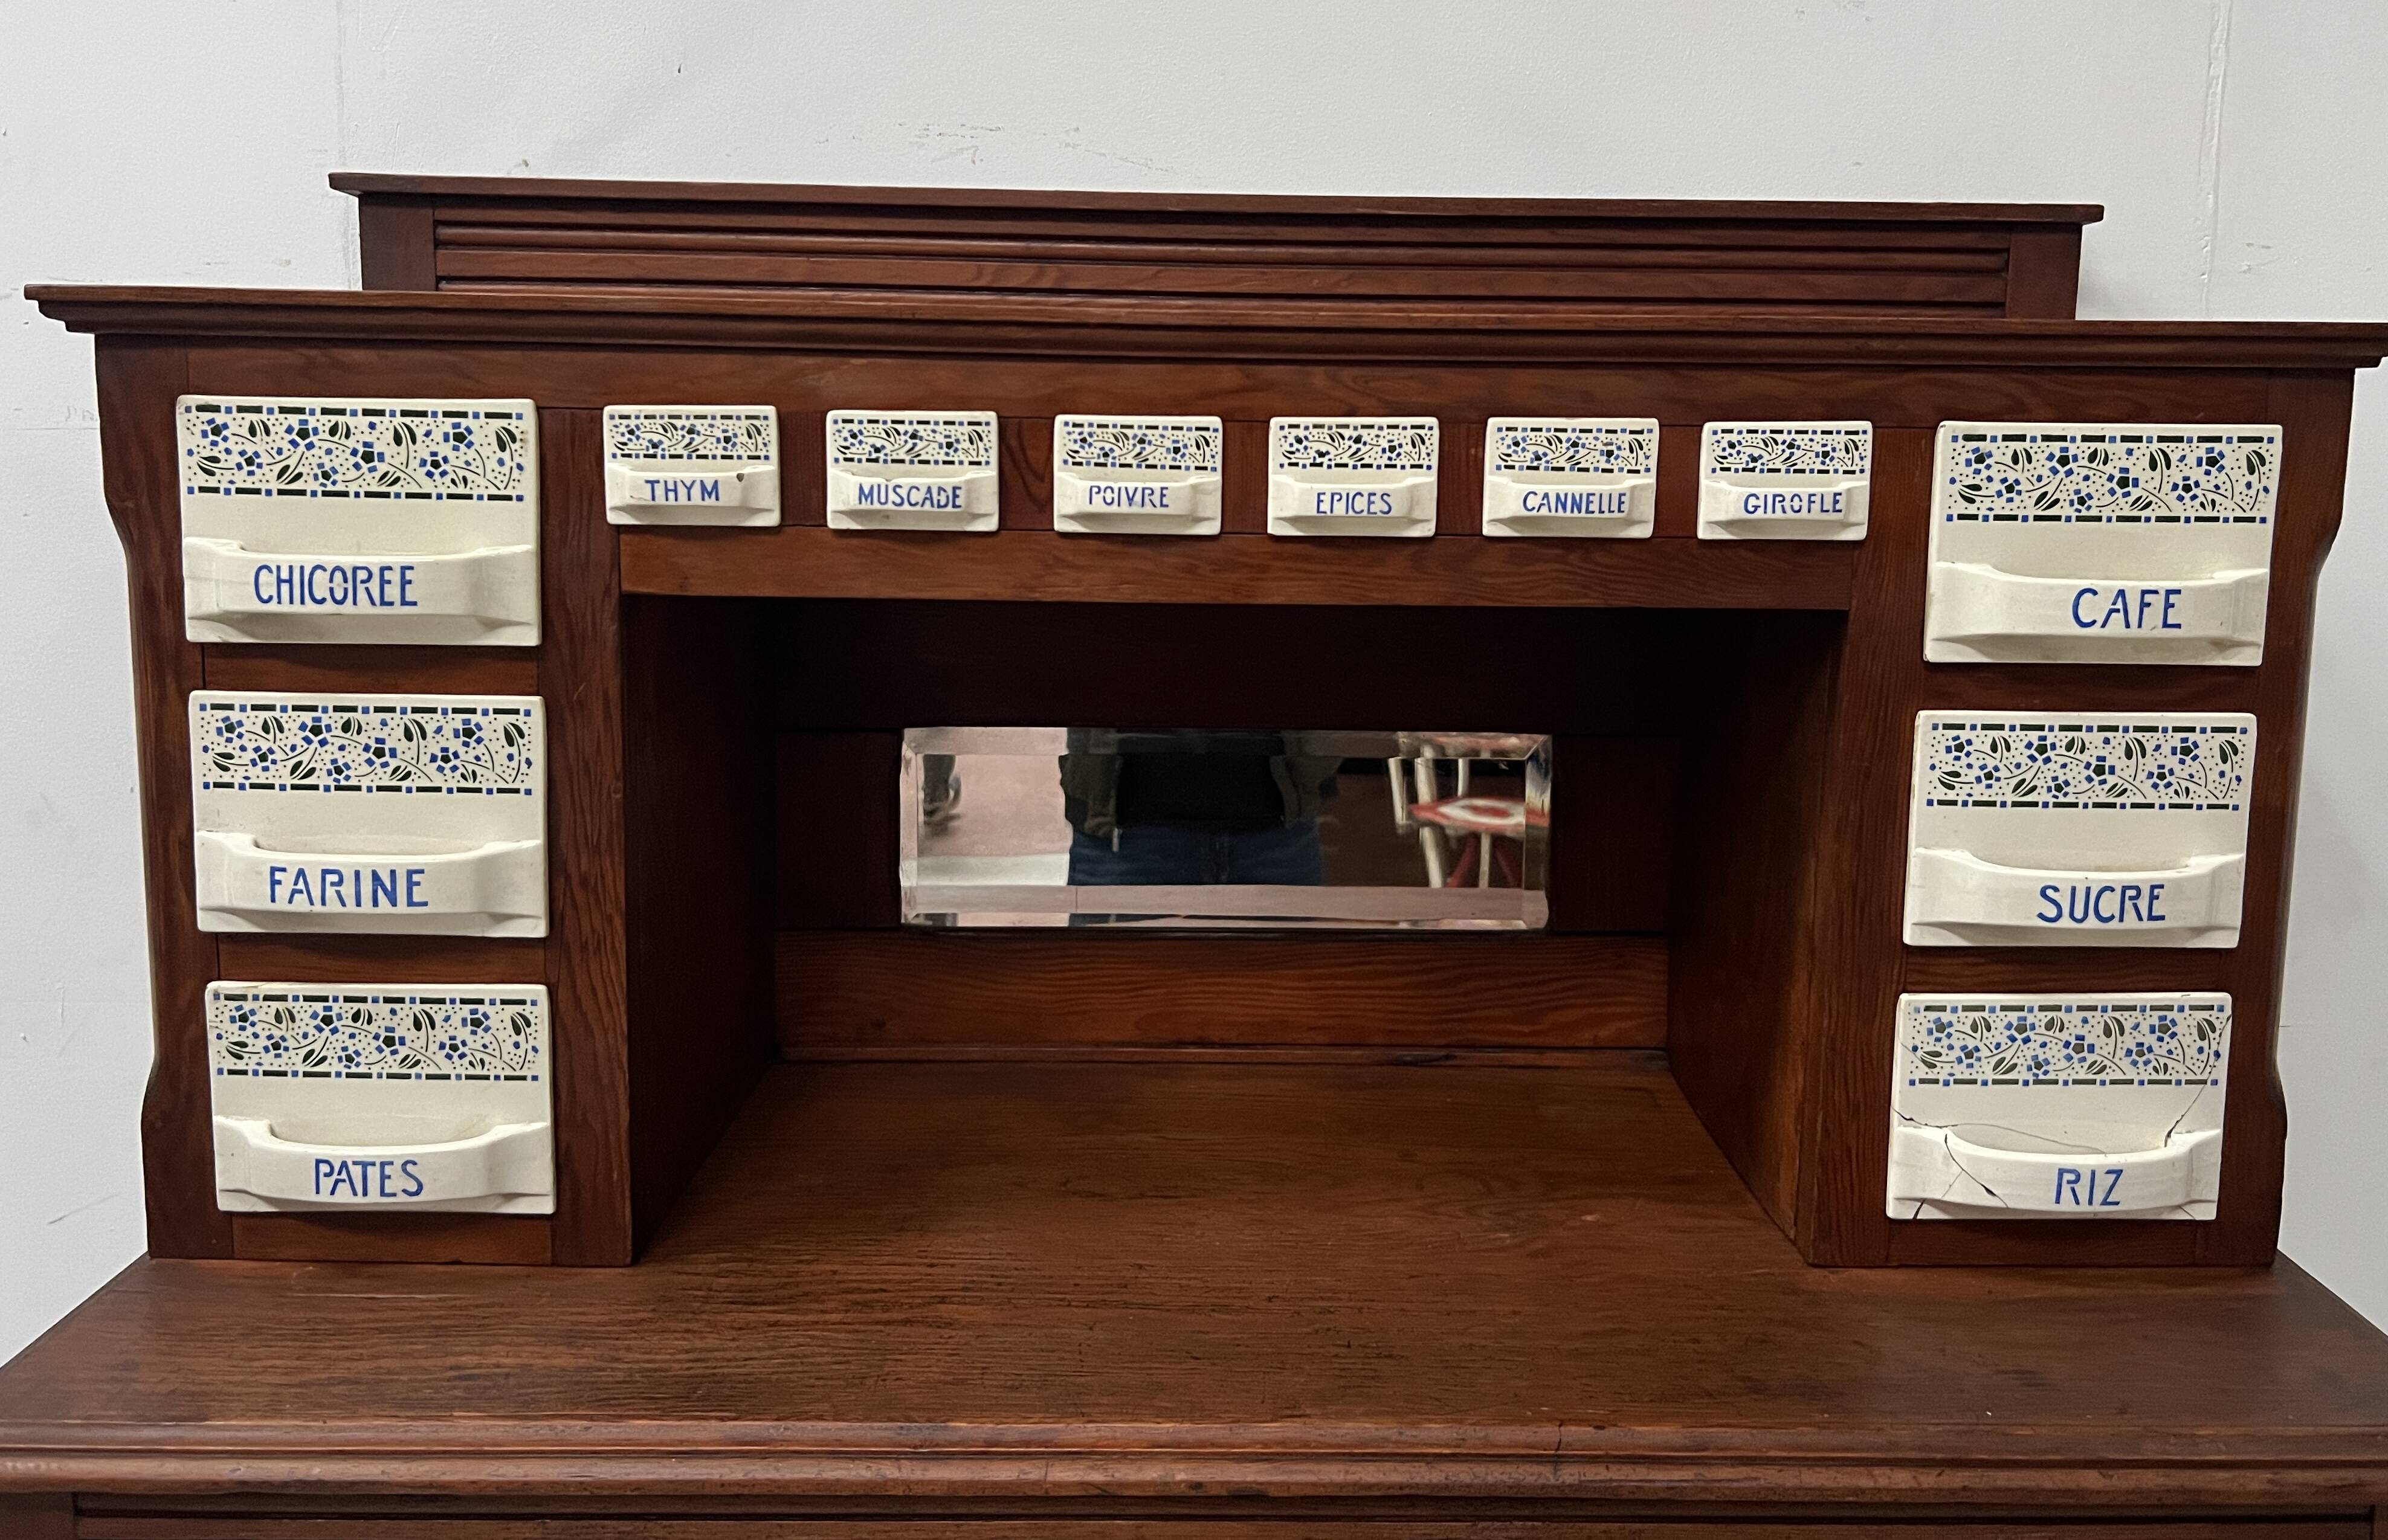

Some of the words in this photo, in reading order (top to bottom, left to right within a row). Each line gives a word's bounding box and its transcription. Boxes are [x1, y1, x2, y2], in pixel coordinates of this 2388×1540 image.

[645, 480, 720, 503] THYM
[858, 483, 963, 509] MUSCADE
[1089, 485, 1169, 507] POIVRE
[1316, 492, 1392, 515] EPICES
[1523, 491, 1627, 515] CANNELLE
[1743, 492, 1842, 515] GIROFLE
[254, 563, 418, 608] CHICOREE
[2071, 587, 2182, 629] CAFE
[269, 865, 429, 909] FARINE
[2037, 883, 2166, 924] SUCRE
[314, 1157, 424, 1199] PATES
[2054, 1167, 2124, 1207] RIZ
